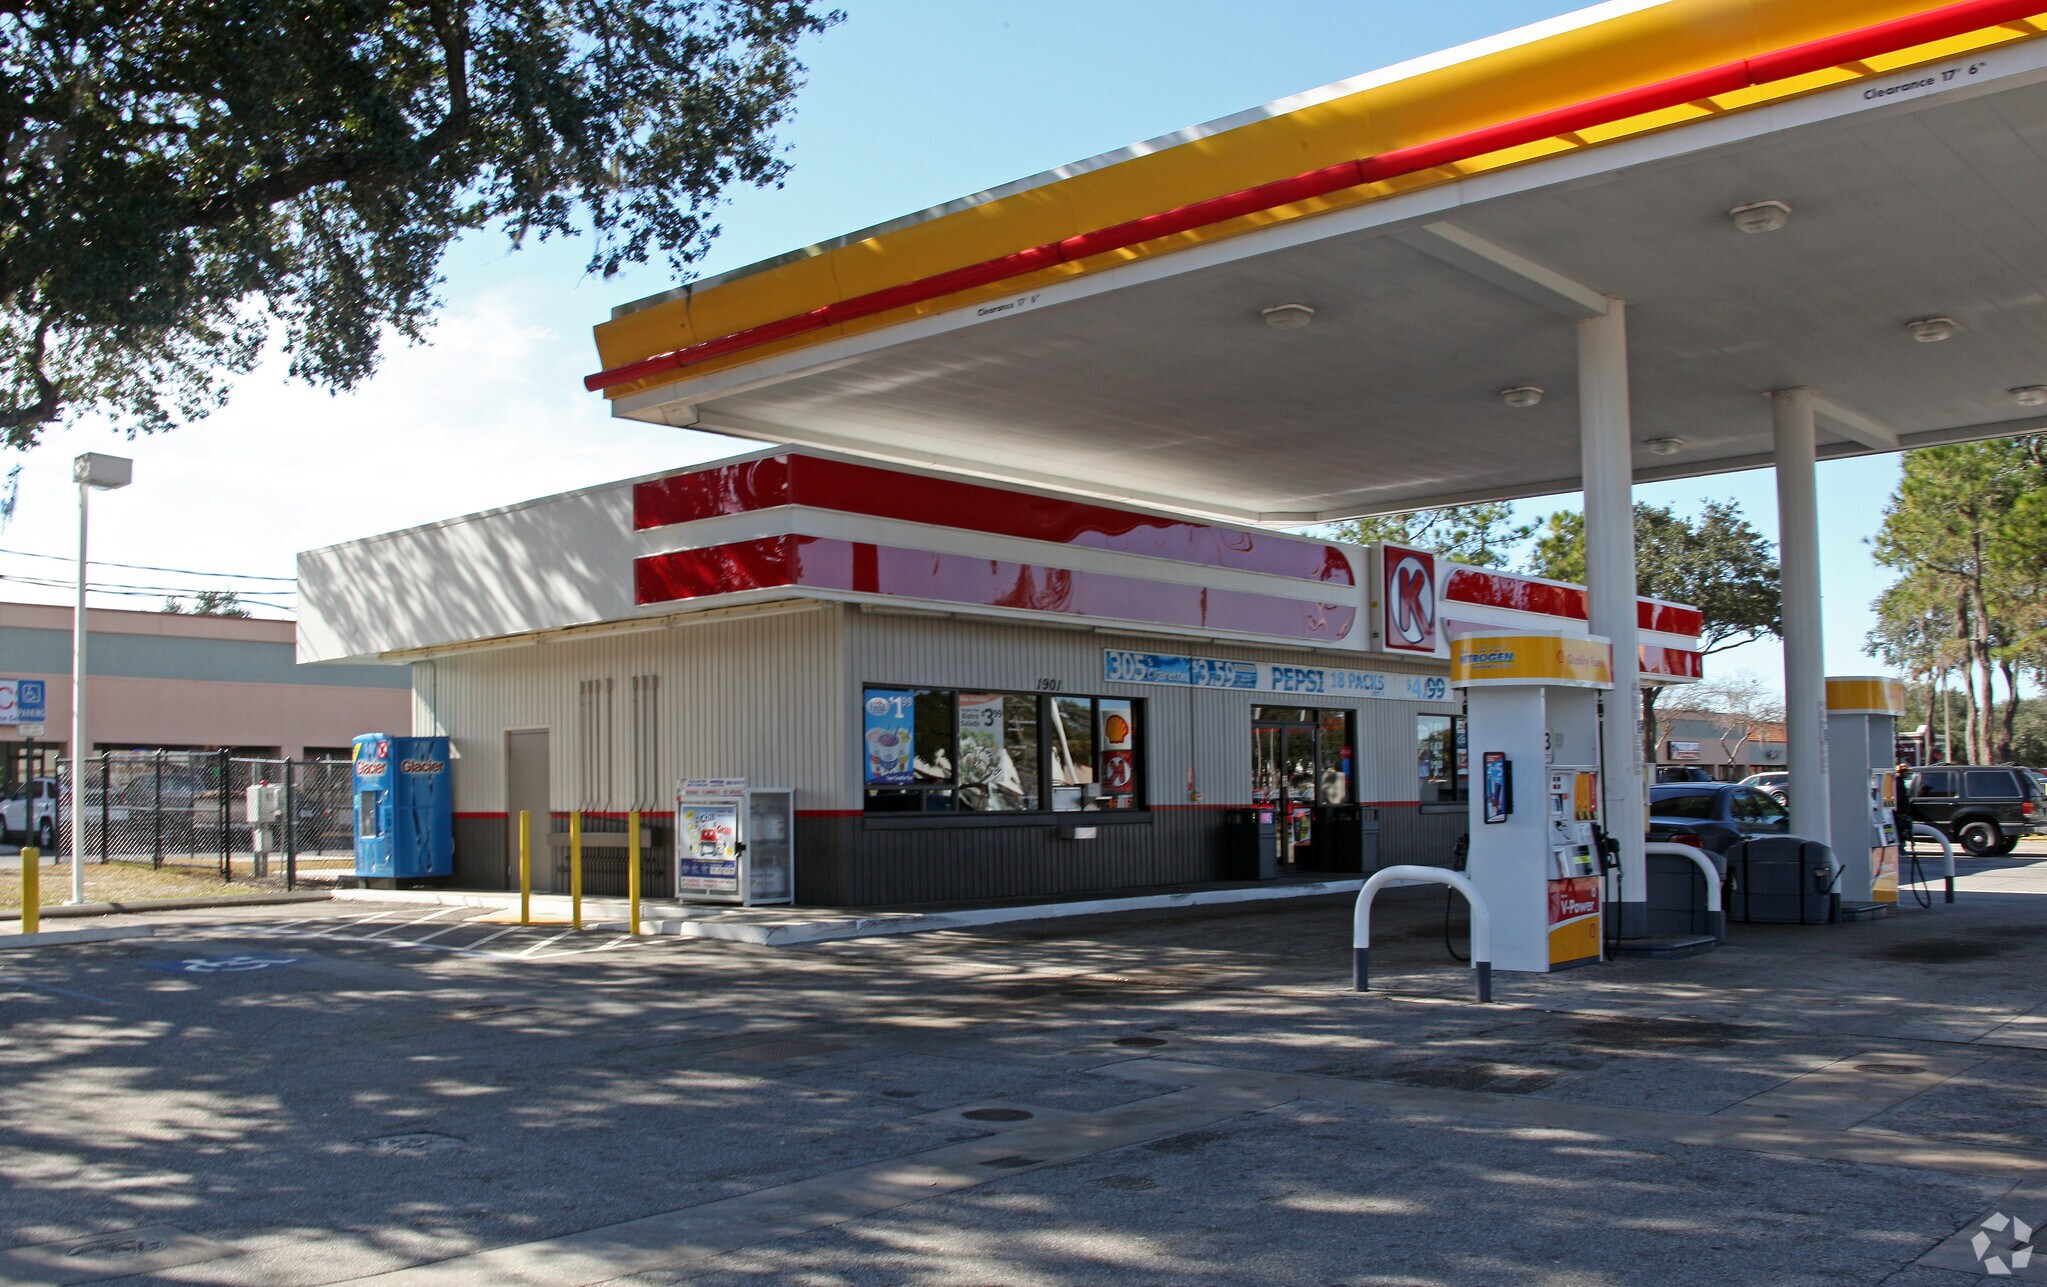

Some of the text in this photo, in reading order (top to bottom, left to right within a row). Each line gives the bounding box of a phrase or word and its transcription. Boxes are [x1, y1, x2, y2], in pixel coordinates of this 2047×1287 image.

[1863, 61, 1987, 100] Clearance 17' 6"
[977, 303, 1016, 317] Clearance
[1037, 678, 1062, 692] 1901
[1272, 666, 1325, 693] PEPSI
[1331, 671, 1345, 689] 18
[1348, 673, 1385, 691] PACKS
[1406, 677, 1445, 699] $4.99
[356, 761, 387, 775] Glacier
[402, 760, 445, 774] Glacier
[1561, 899, 1595, 914] V-Power
